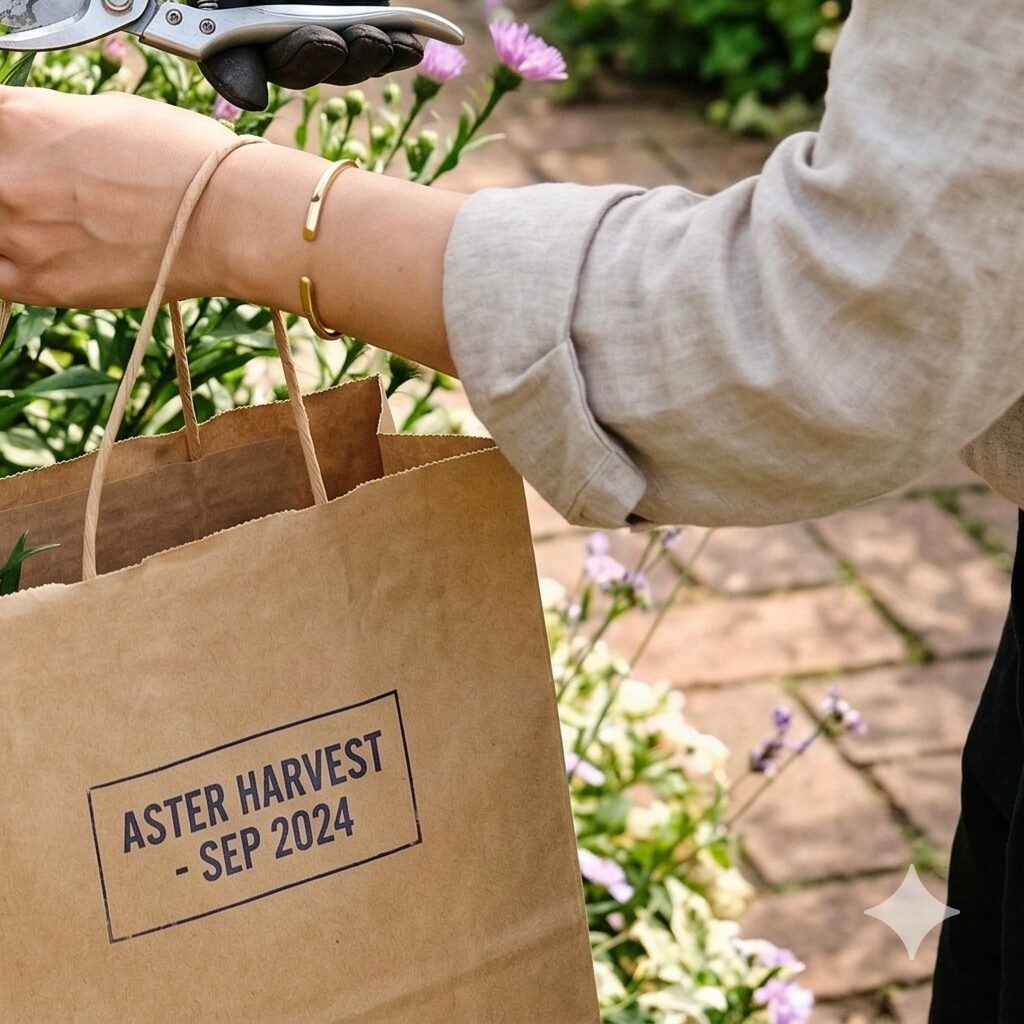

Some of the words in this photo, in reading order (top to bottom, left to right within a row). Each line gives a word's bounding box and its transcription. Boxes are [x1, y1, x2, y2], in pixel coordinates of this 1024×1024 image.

[123, 783, 229, 854] ASTER
[236, 730, 382, 815] HARVEST
[199, 826, 261, 882] SEP
[270, 796, 355, 860] 2024
